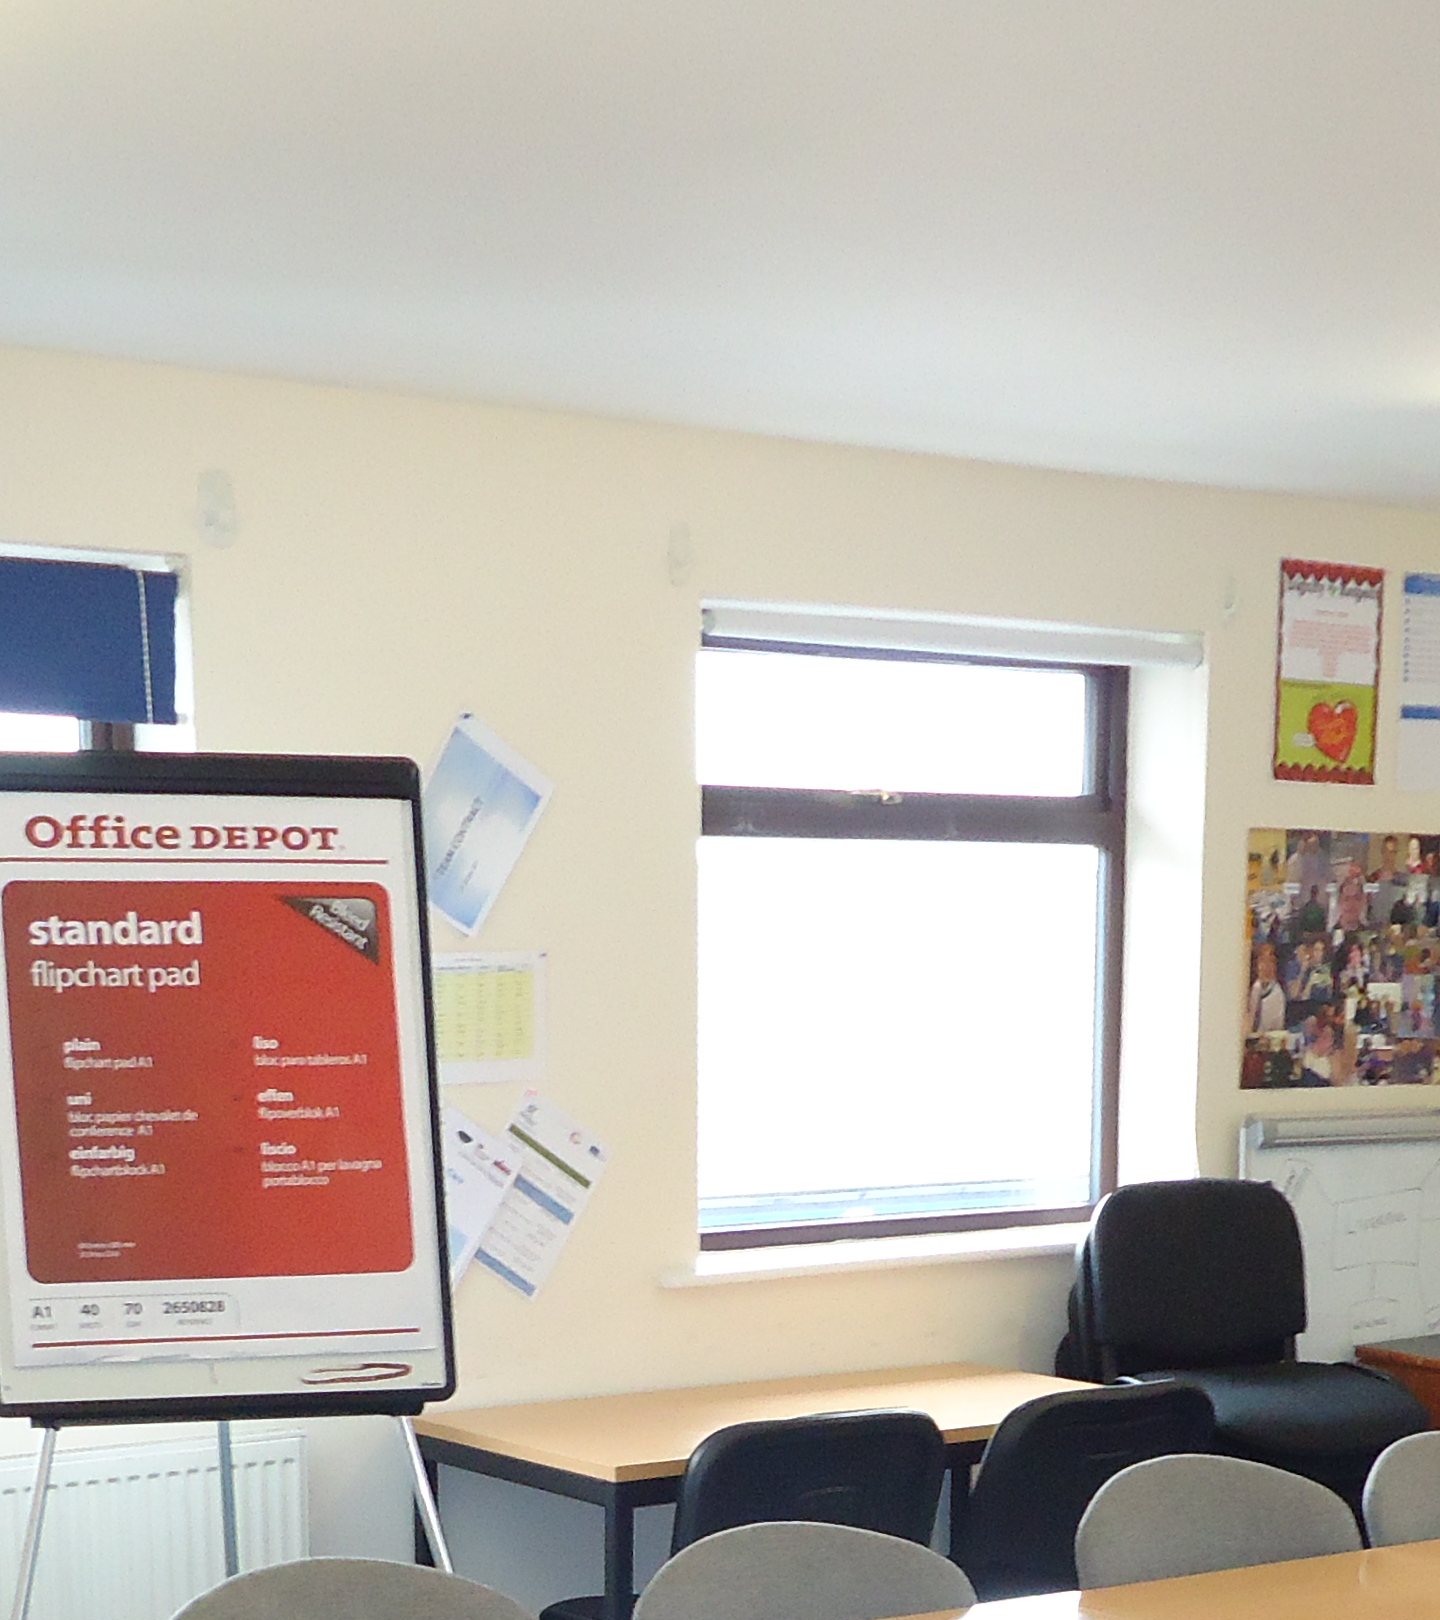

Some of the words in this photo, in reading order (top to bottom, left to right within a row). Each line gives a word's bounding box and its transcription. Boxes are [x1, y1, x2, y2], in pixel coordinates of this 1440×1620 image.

[25, 814, 180, 849] Office
[190, 825, 339, 851] DEPOT
[29, 911, 203, 946] standard
[30, 959, 143, 993] flipchart
[148, 959, 201, 993] pad
[62, 1037, 102, 1055] plain
[31, 1305, 53, 1319] A1
[79, 1304, 100, 1317] 40
[122, 1302, 144, 1316] 70
